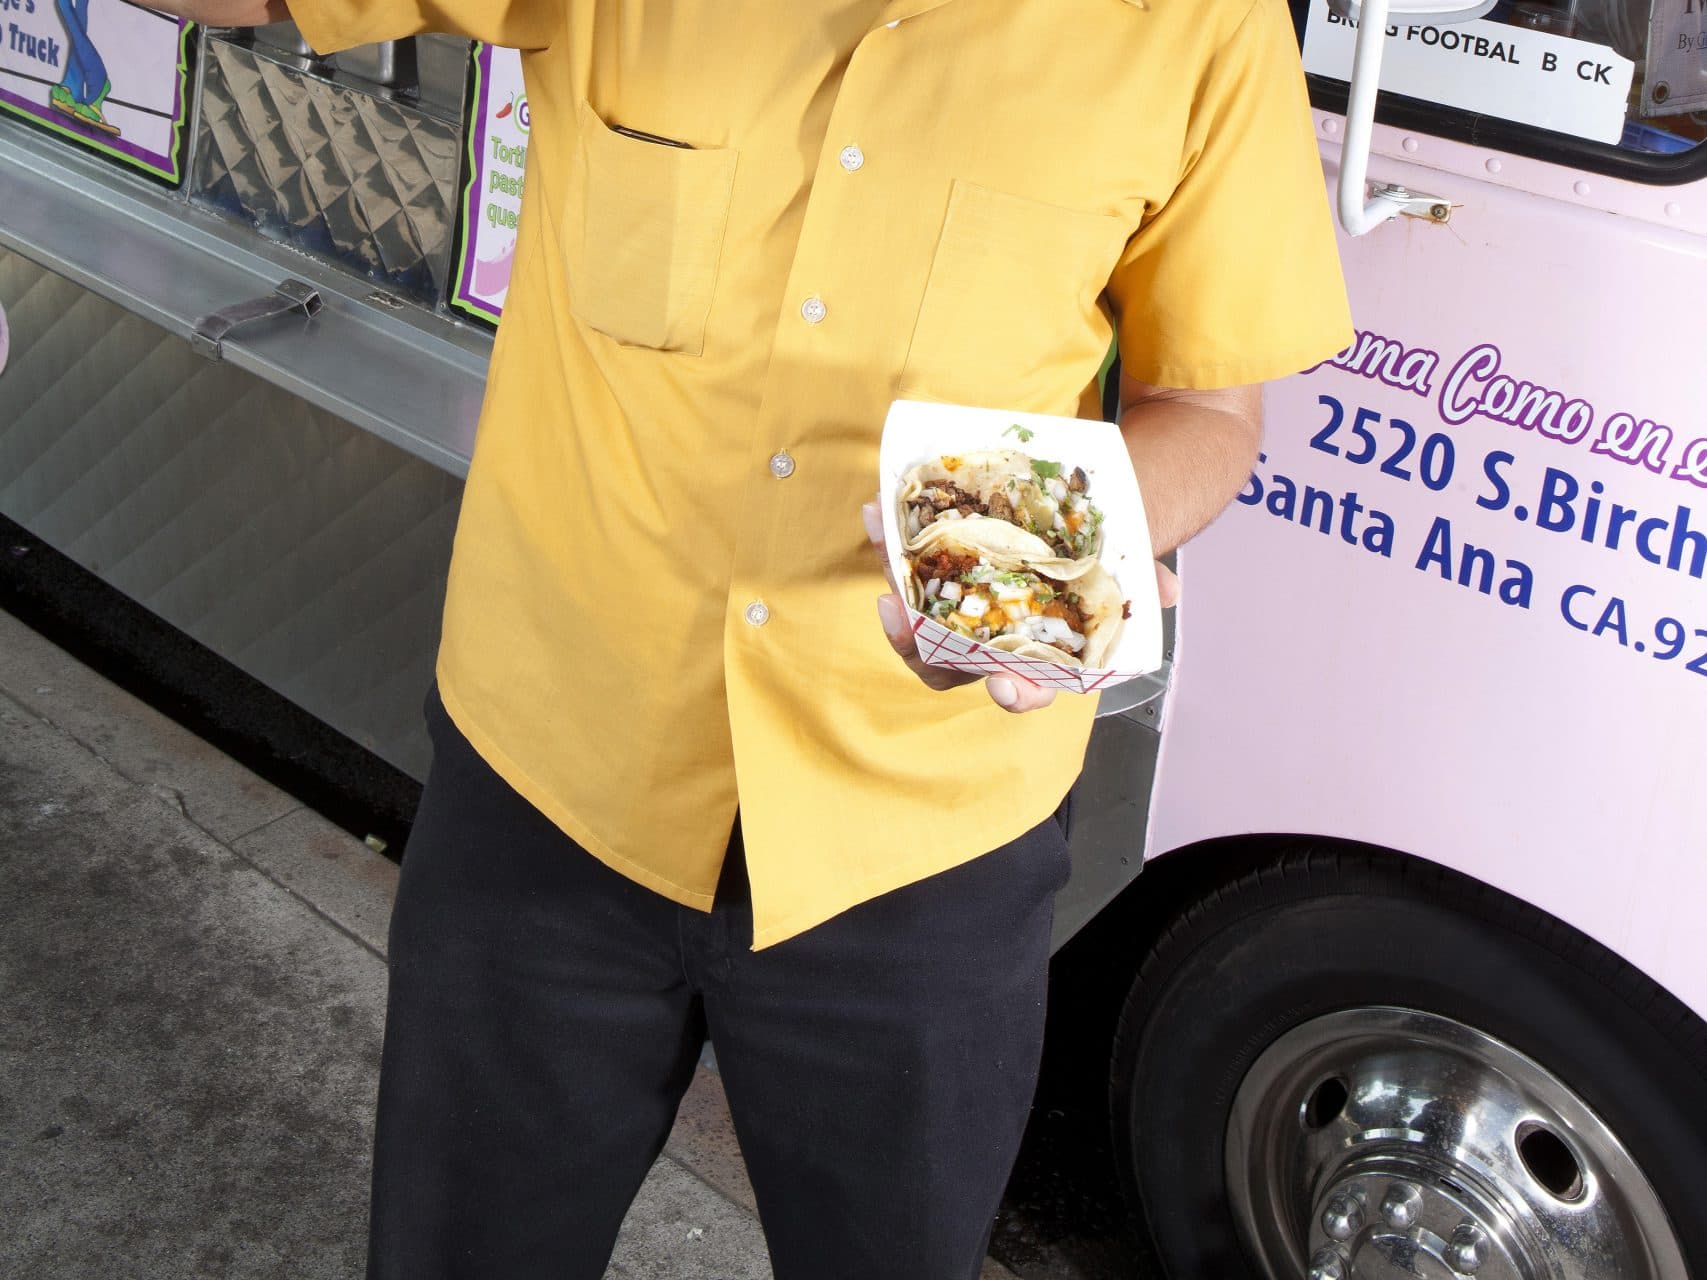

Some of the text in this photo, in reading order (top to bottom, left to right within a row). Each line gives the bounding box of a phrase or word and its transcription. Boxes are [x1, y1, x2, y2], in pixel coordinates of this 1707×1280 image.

[9, 22, 60, 68] Truck
[1406, 25, 1521, 65] FOOTBAL
[491, 135, 527, 169] Torti
[489, 169, 524, 200] past
[1438, 343, 1595, 446] Como
[1590, 412, 1675, 475] en
[1310, 393, 1707, 580] 2520 S.Birch
[1415, 515, 1534, 610] Ana
